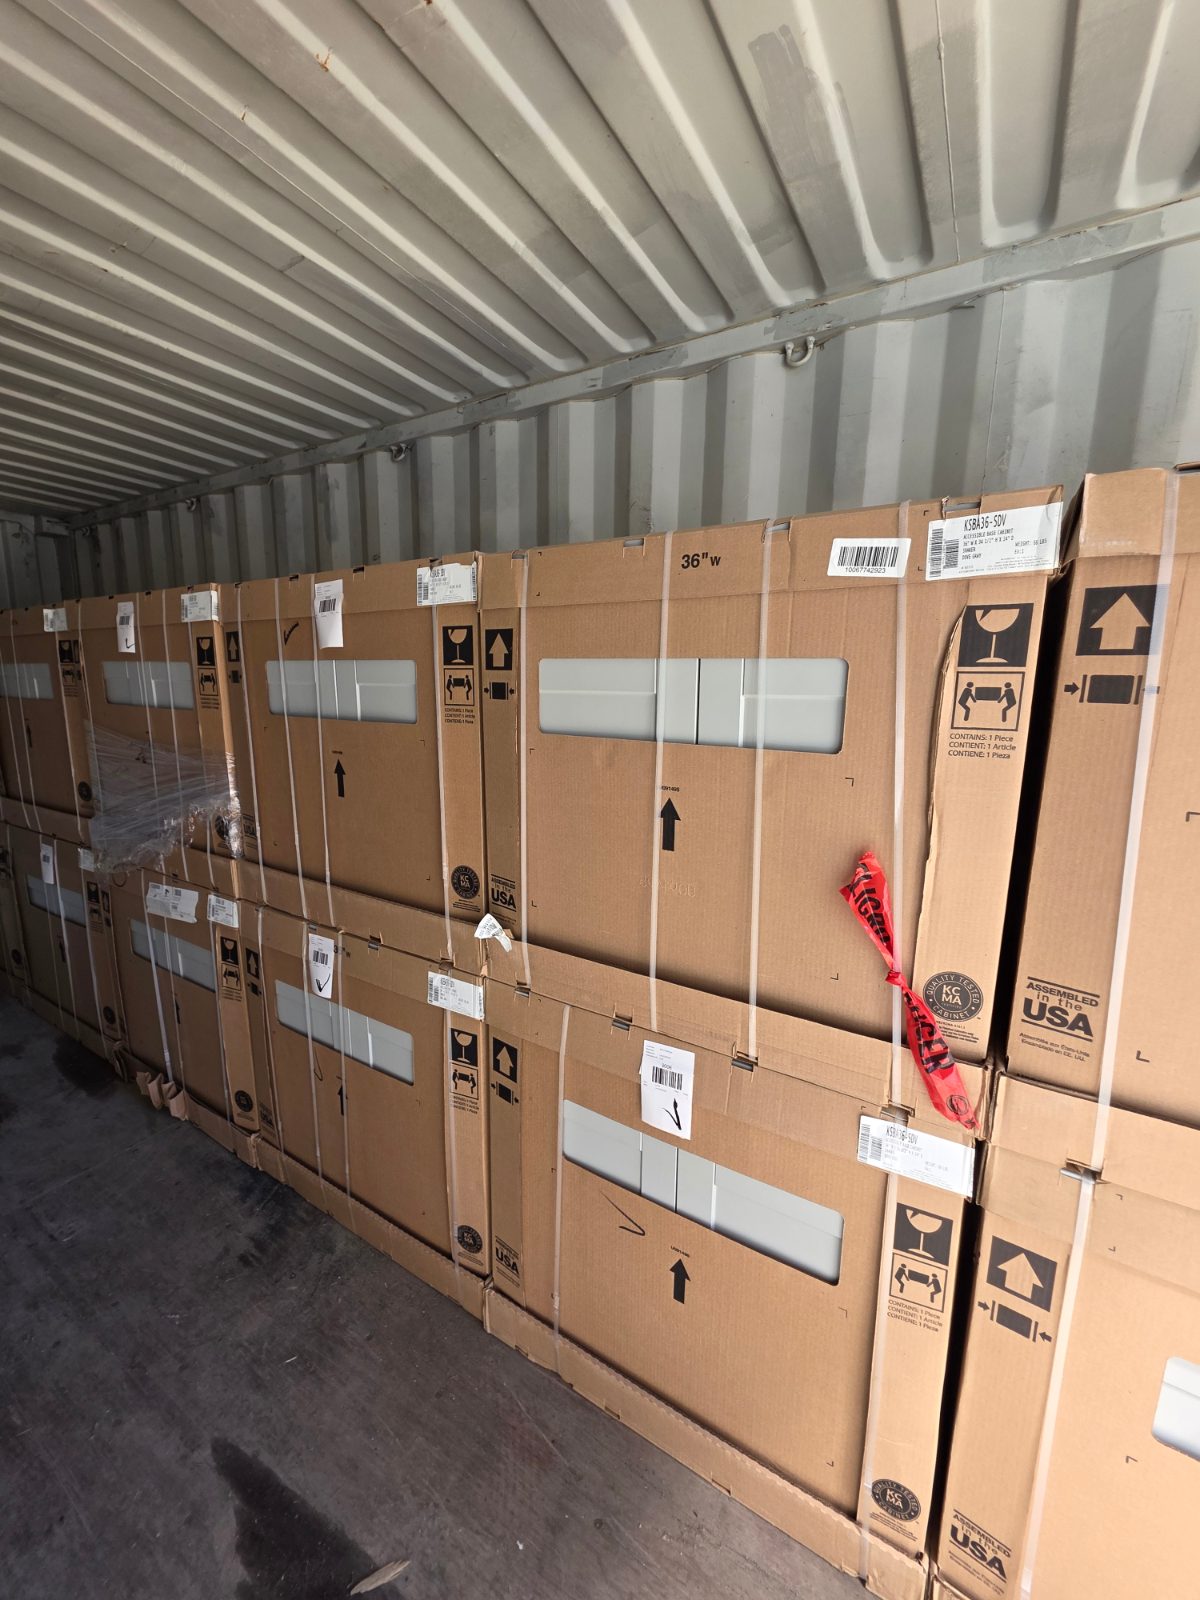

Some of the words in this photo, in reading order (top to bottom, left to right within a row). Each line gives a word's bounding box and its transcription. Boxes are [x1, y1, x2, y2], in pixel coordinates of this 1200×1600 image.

[964, 513, 1007, 532] KSBA36-SDV
[950, 733, 987, 741] CONTAINS:
[491, 887, 516, 909] USA
[926, 974, 955, 995] QUALITY
[942, 984, 961, 996] KC
[959, 976, 980, 1004] TESTED
[1026, 982, 1099, 1007] ASSEMBLED
[941, 993, 962, 1005] MA
[1036, 992, 1050, 1002] in
[1058, 998, 1082, 1011] the
[932, 1005, 970, 1019] CABINET
[1023, 997, 1093, 1037] USA
[495, 1246, 519, 1276] USA
[953, 1514, 1011, 1558] ASSEMBLED
[950, 1524, 1007, 1580] USA
